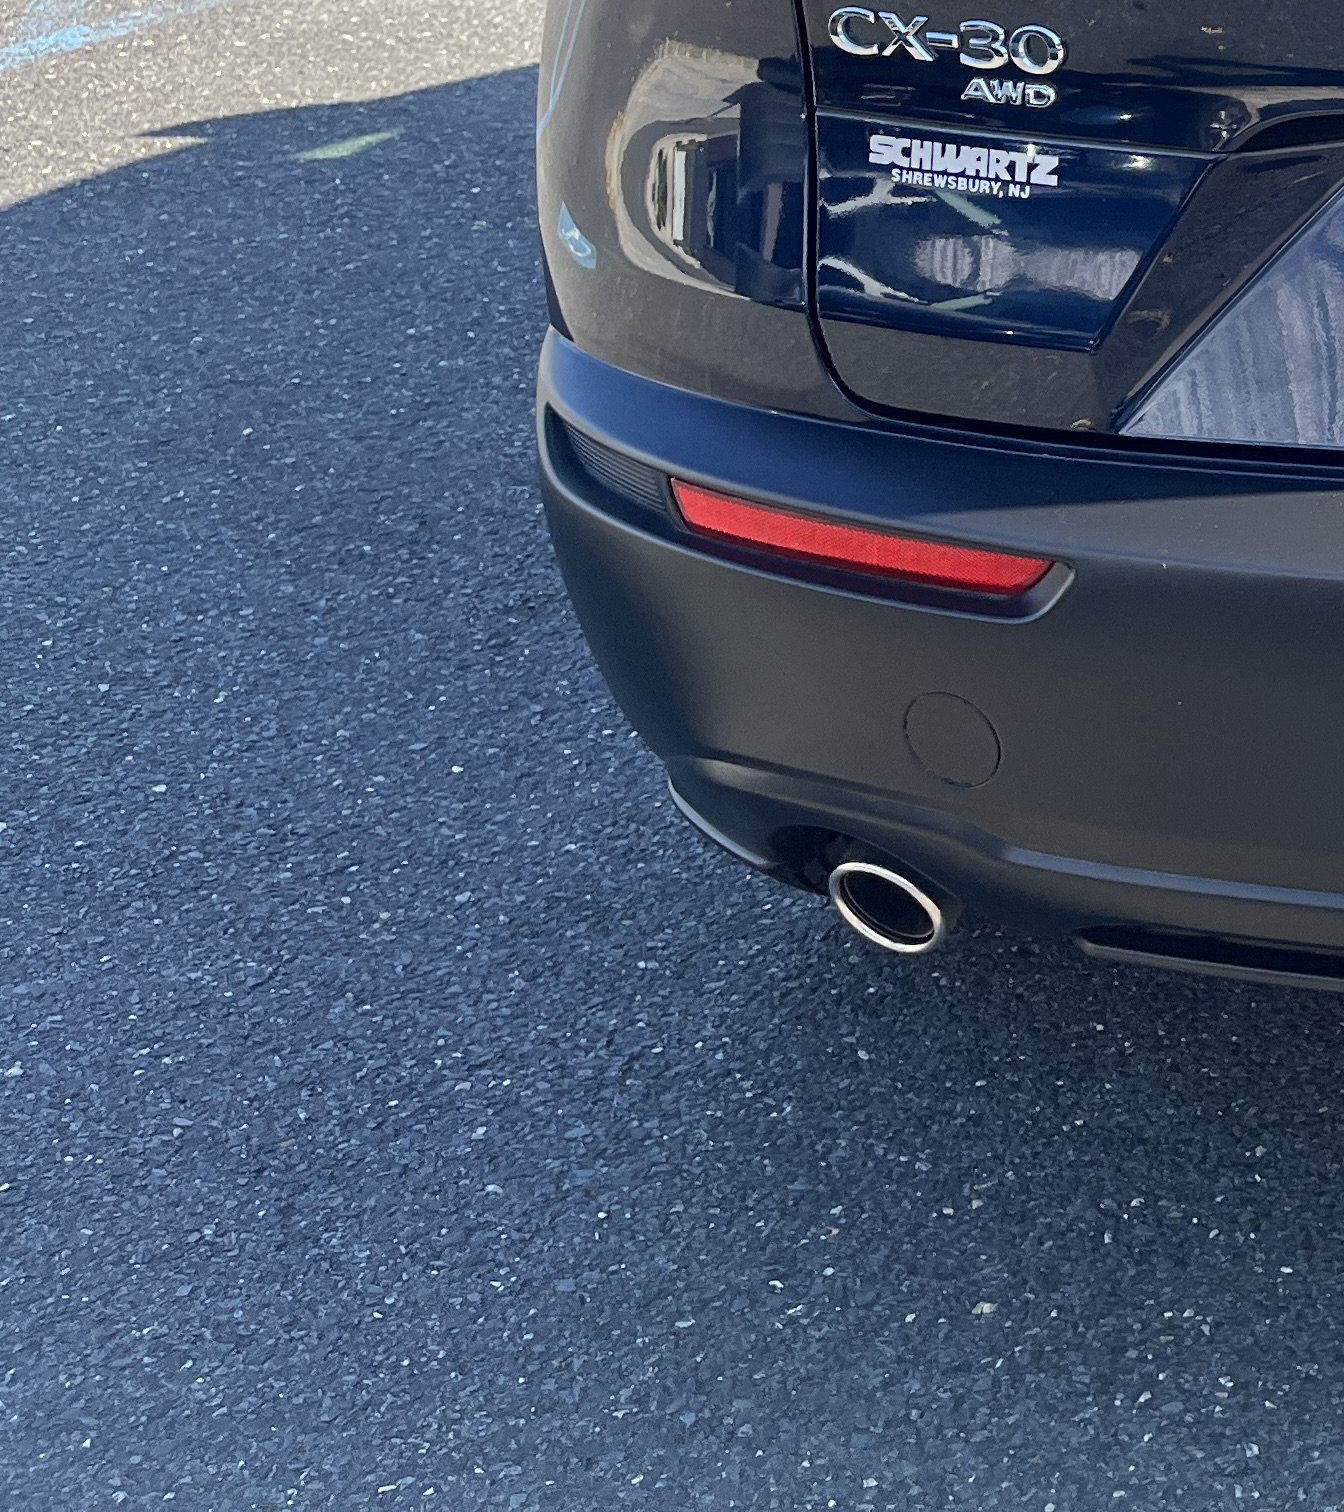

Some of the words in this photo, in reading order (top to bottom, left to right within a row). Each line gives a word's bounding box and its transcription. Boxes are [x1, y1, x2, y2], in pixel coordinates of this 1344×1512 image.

[828, 6, 1065, 75] CX-30
[960, 76, 1057, 108] AWD
[868, 134, 1059, 186] SCHWARTZ
[891, 168, 1004, 198] SHREWSBURY,
[1008, 182, 1031, 199] NJ
